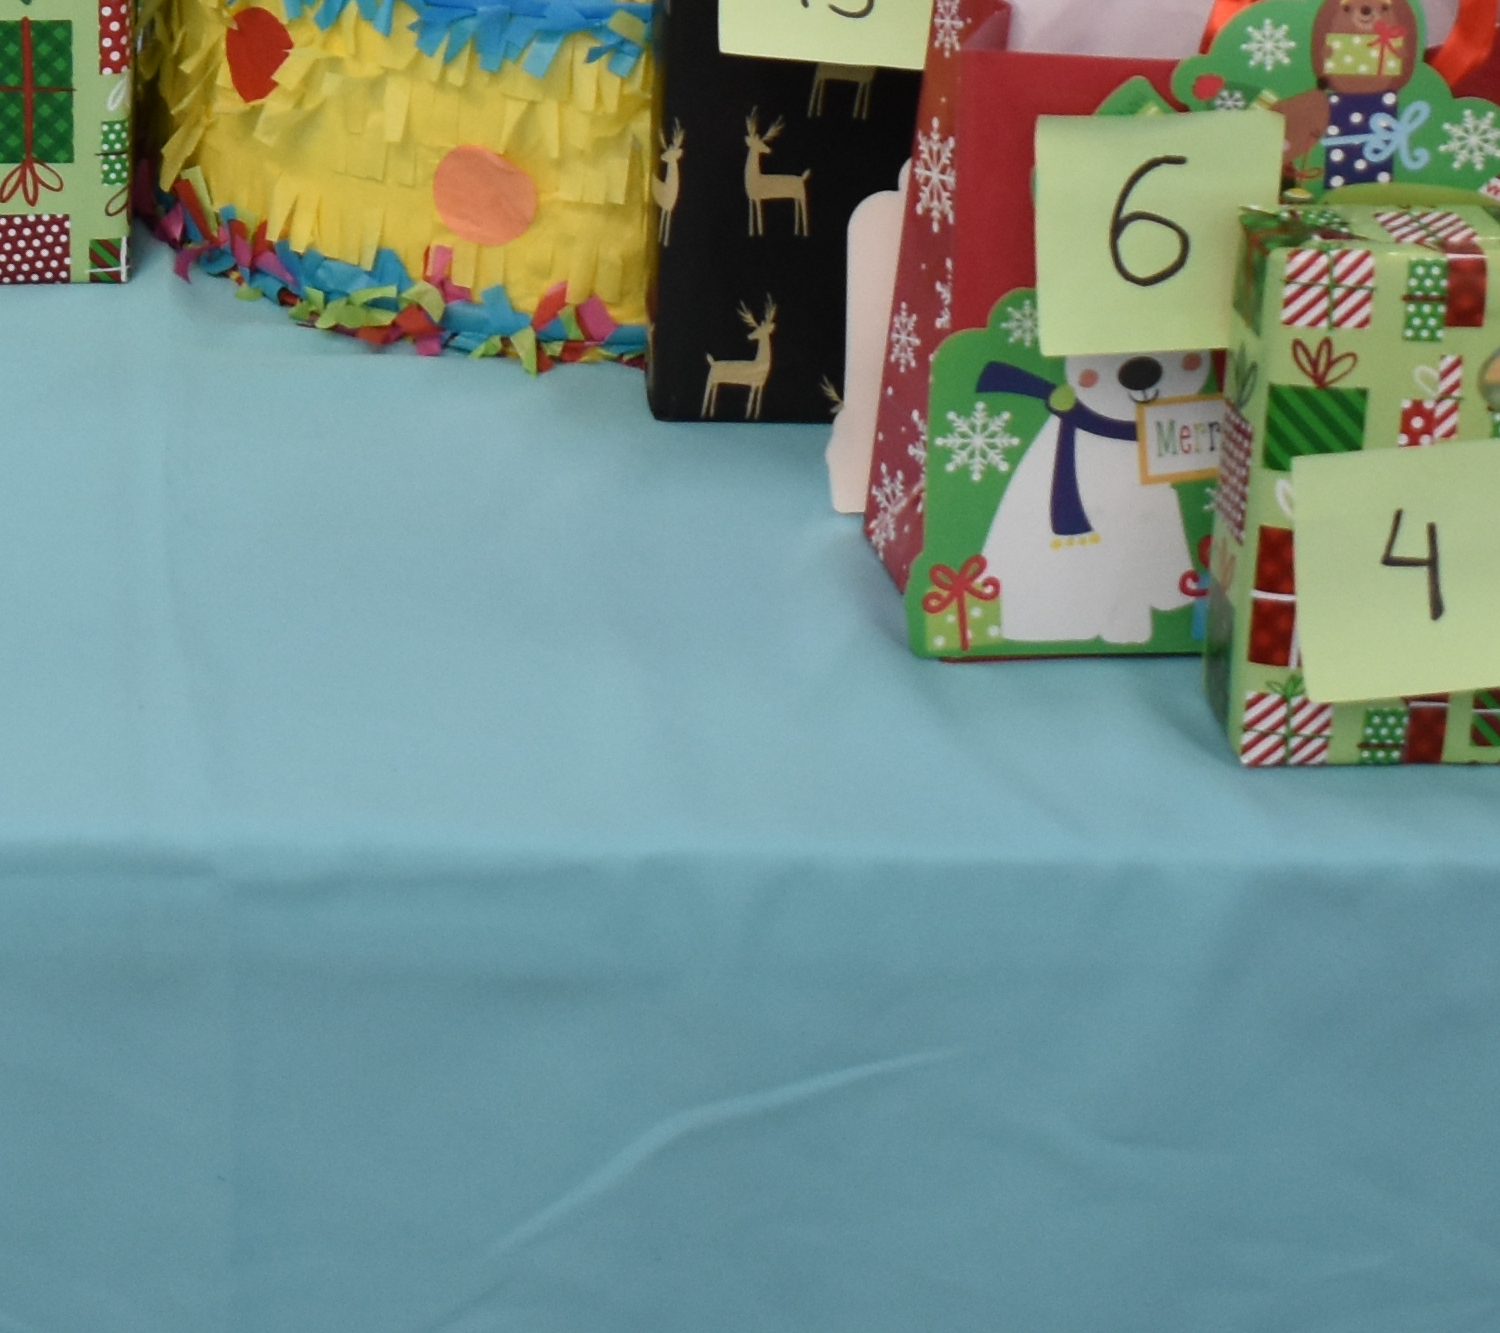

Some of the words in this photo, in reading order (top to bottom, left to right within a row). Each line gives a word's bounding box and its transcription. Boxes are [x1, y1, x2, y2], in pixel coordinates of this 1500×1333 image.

[1108, 154, 1192, 288] 6
[1156, 419, 1221, 457] Merr
[1380, 508, 1445, 622] 4
